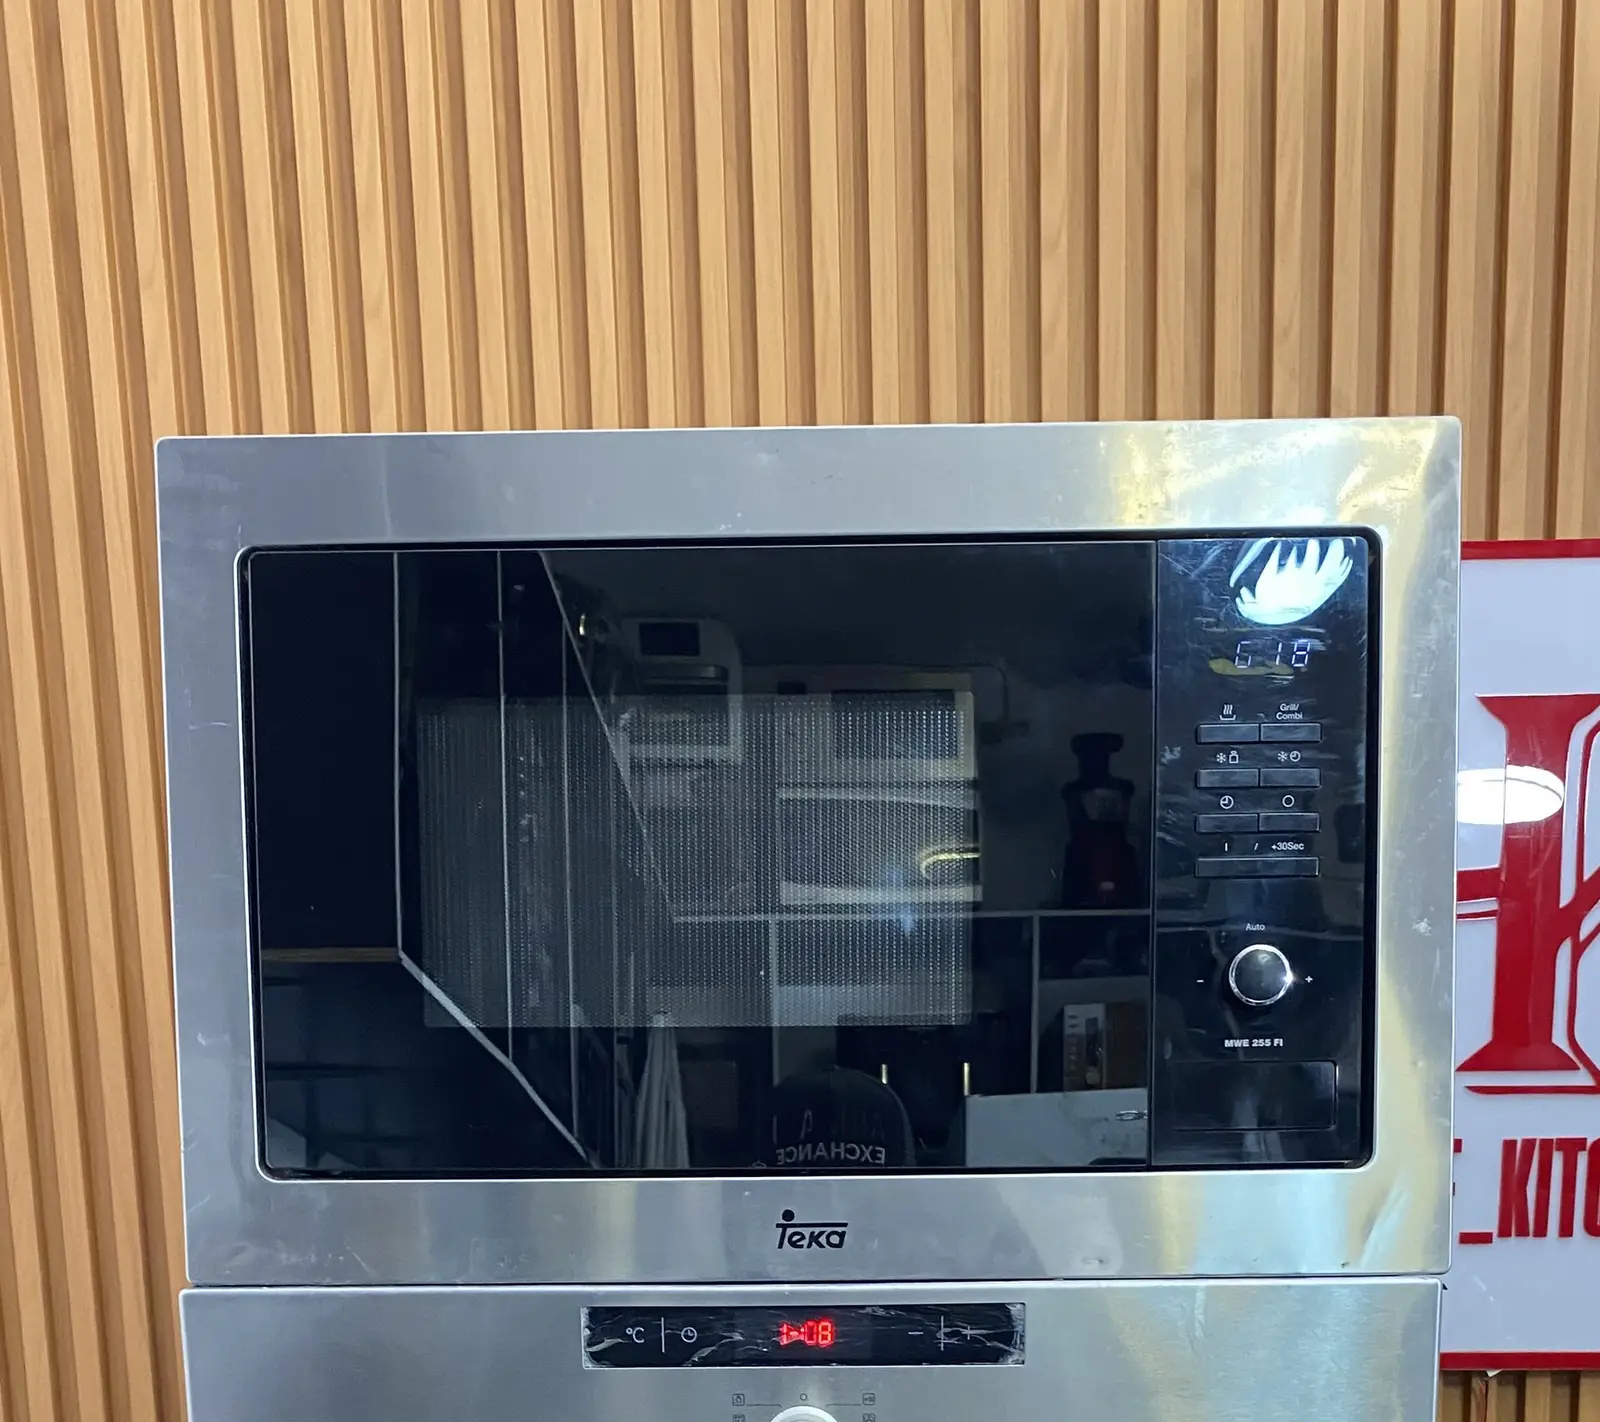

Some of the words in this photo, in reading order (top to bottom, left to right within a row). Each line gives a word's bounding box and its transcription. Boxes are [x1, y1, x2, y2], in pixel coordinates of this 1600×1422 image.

[1275, 712, 1303, 720] Combi
[1271, 842, 1305, 851] +30Sec
[1245, 923, 1265, 931] Auto
[1224, 1039, 1250, 1048] MWE
[1251, 1038, 1272, 1047] 255
[1273, 1038, 1284, 1047] FI
